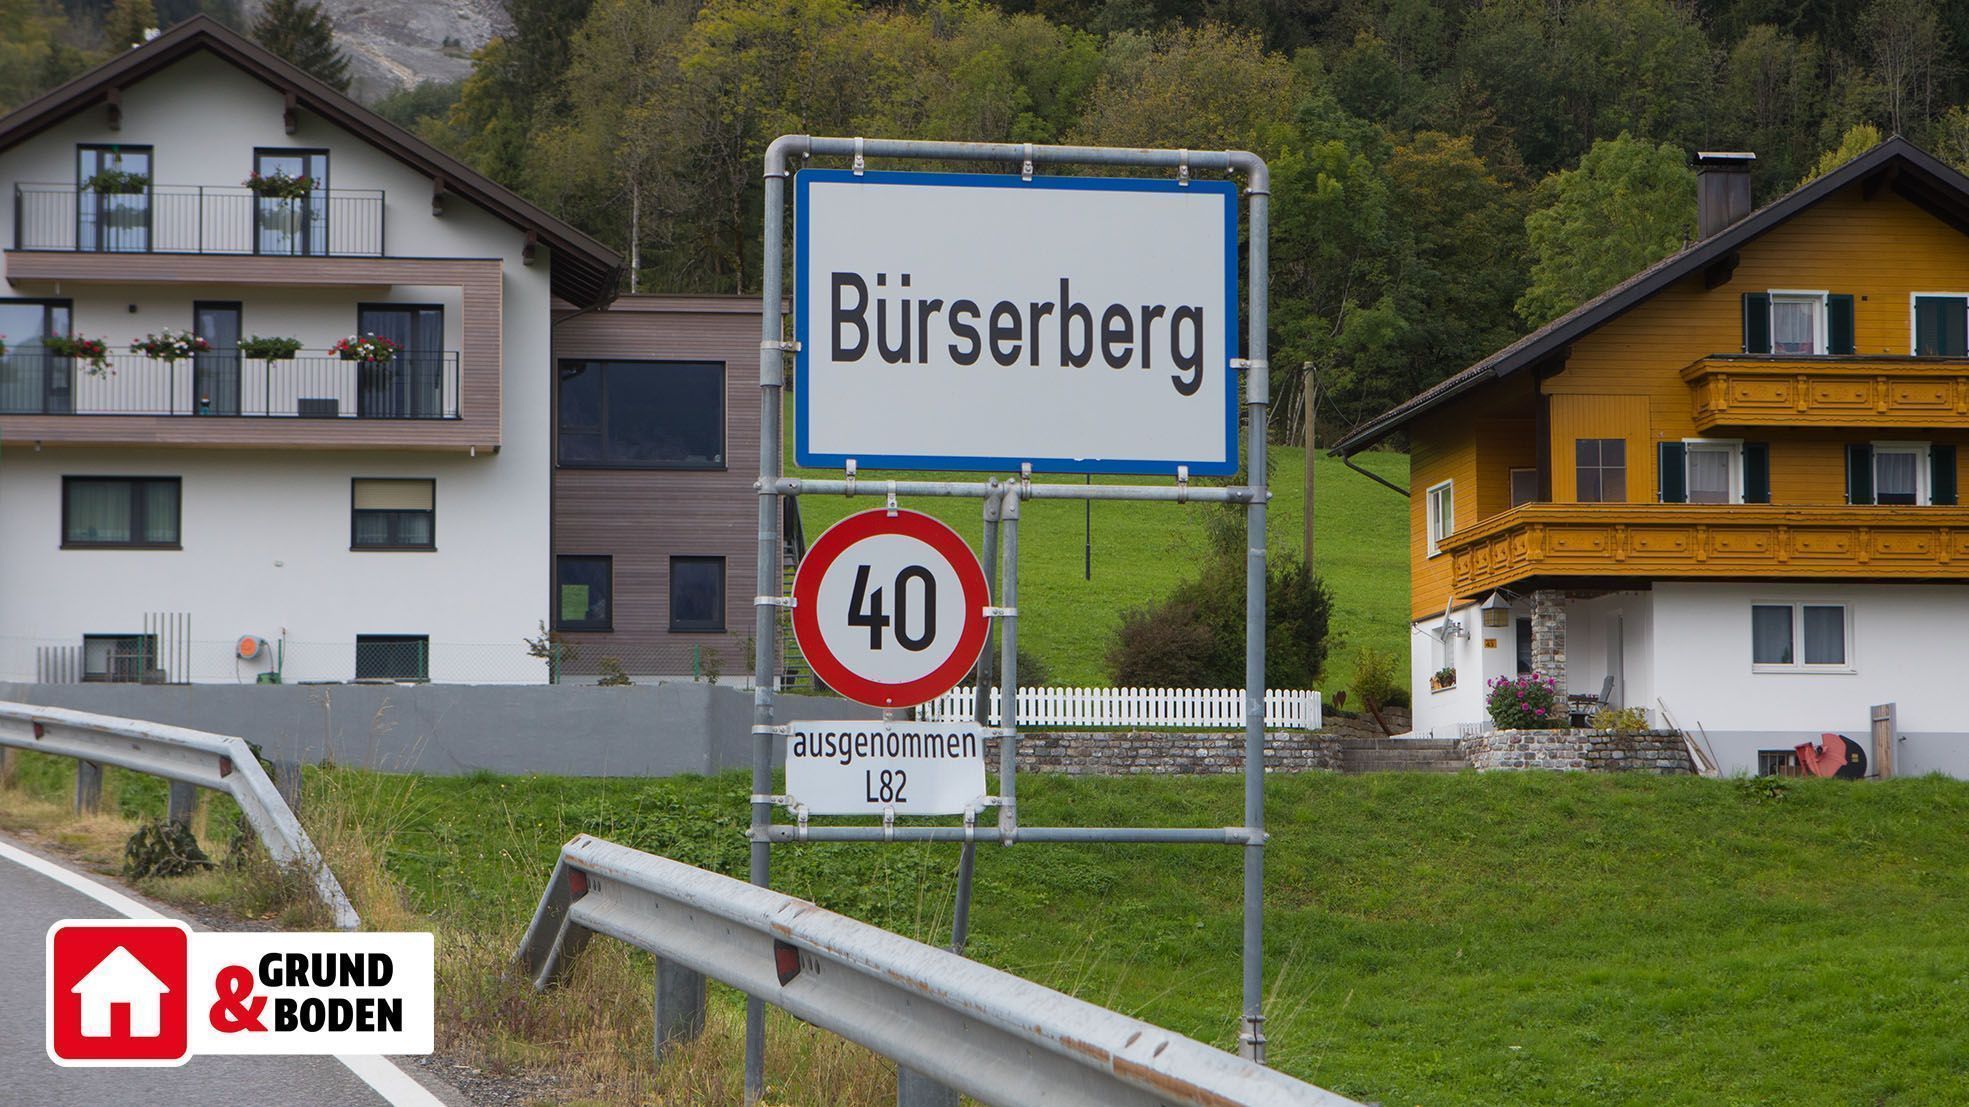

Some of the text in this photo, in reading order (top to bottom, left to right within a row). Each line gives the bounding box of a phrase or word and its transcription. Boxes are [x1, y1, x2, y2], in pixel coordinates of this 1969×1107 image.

[832, 272, 1204, 397] Bürserberg
[847, 564, 937, 652] 40
[793, 731, 977, 766] ausgenommen
[866, 769, 907, 803] L82
